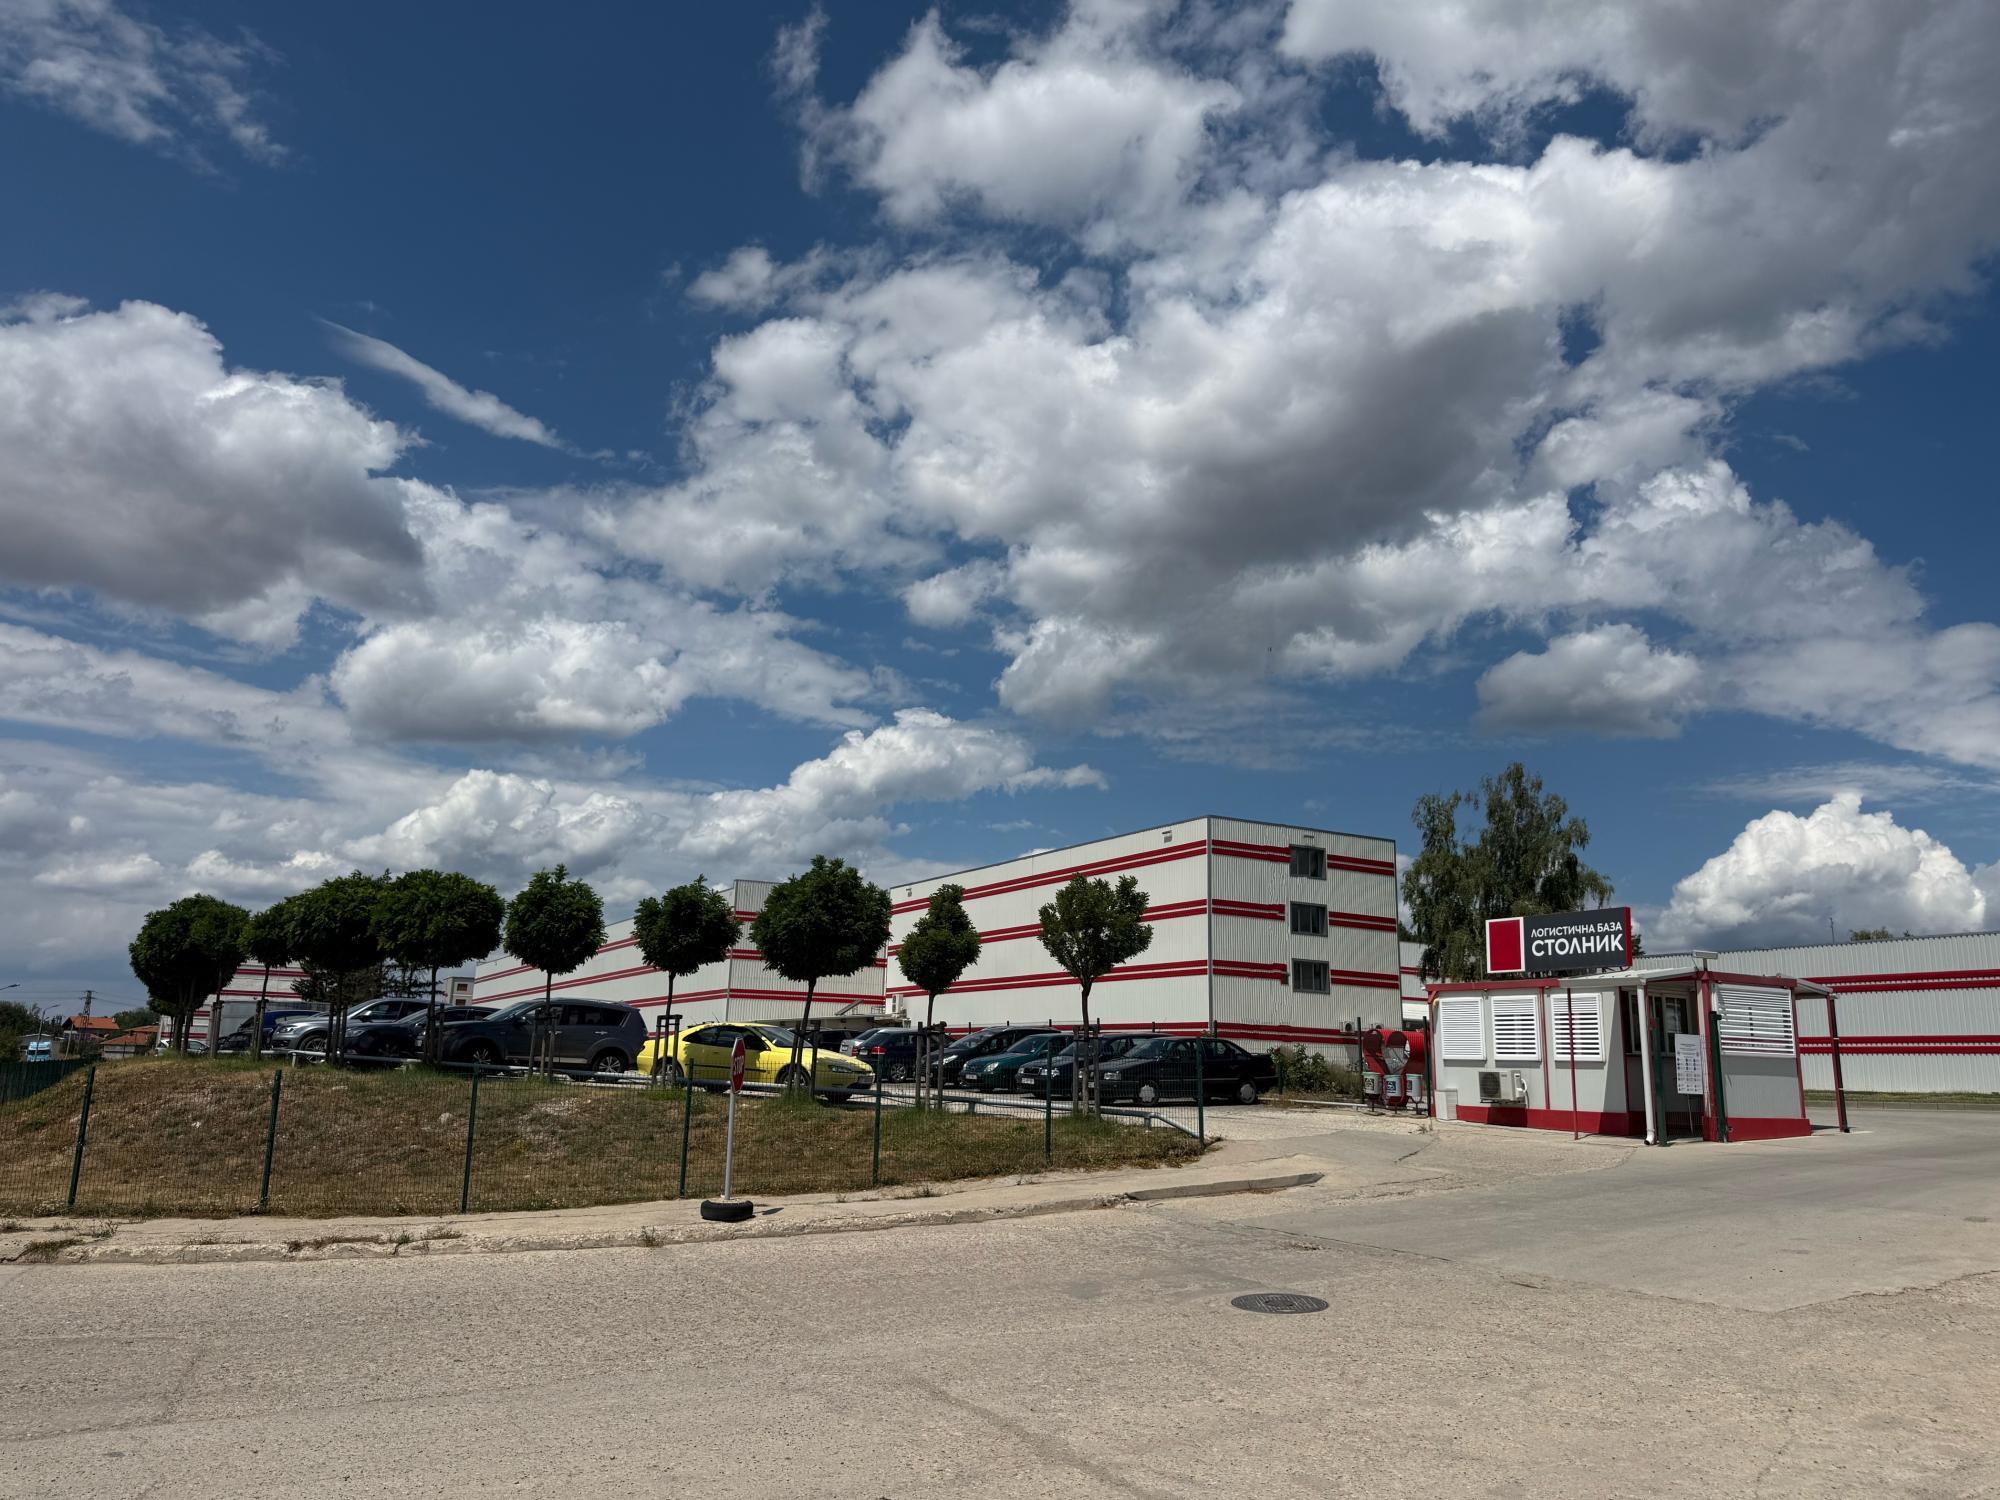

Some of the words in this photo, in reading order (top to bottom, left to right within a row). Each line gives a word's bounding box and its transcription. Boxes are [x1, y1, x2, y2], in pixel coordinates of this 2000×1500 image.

[1531, 923, 1595, 938] ЛОГИСТИЧНА
[1597, 921, 1622, 933] БАЗА
[1531, 933, 1624, 957] СТОЛНИК
